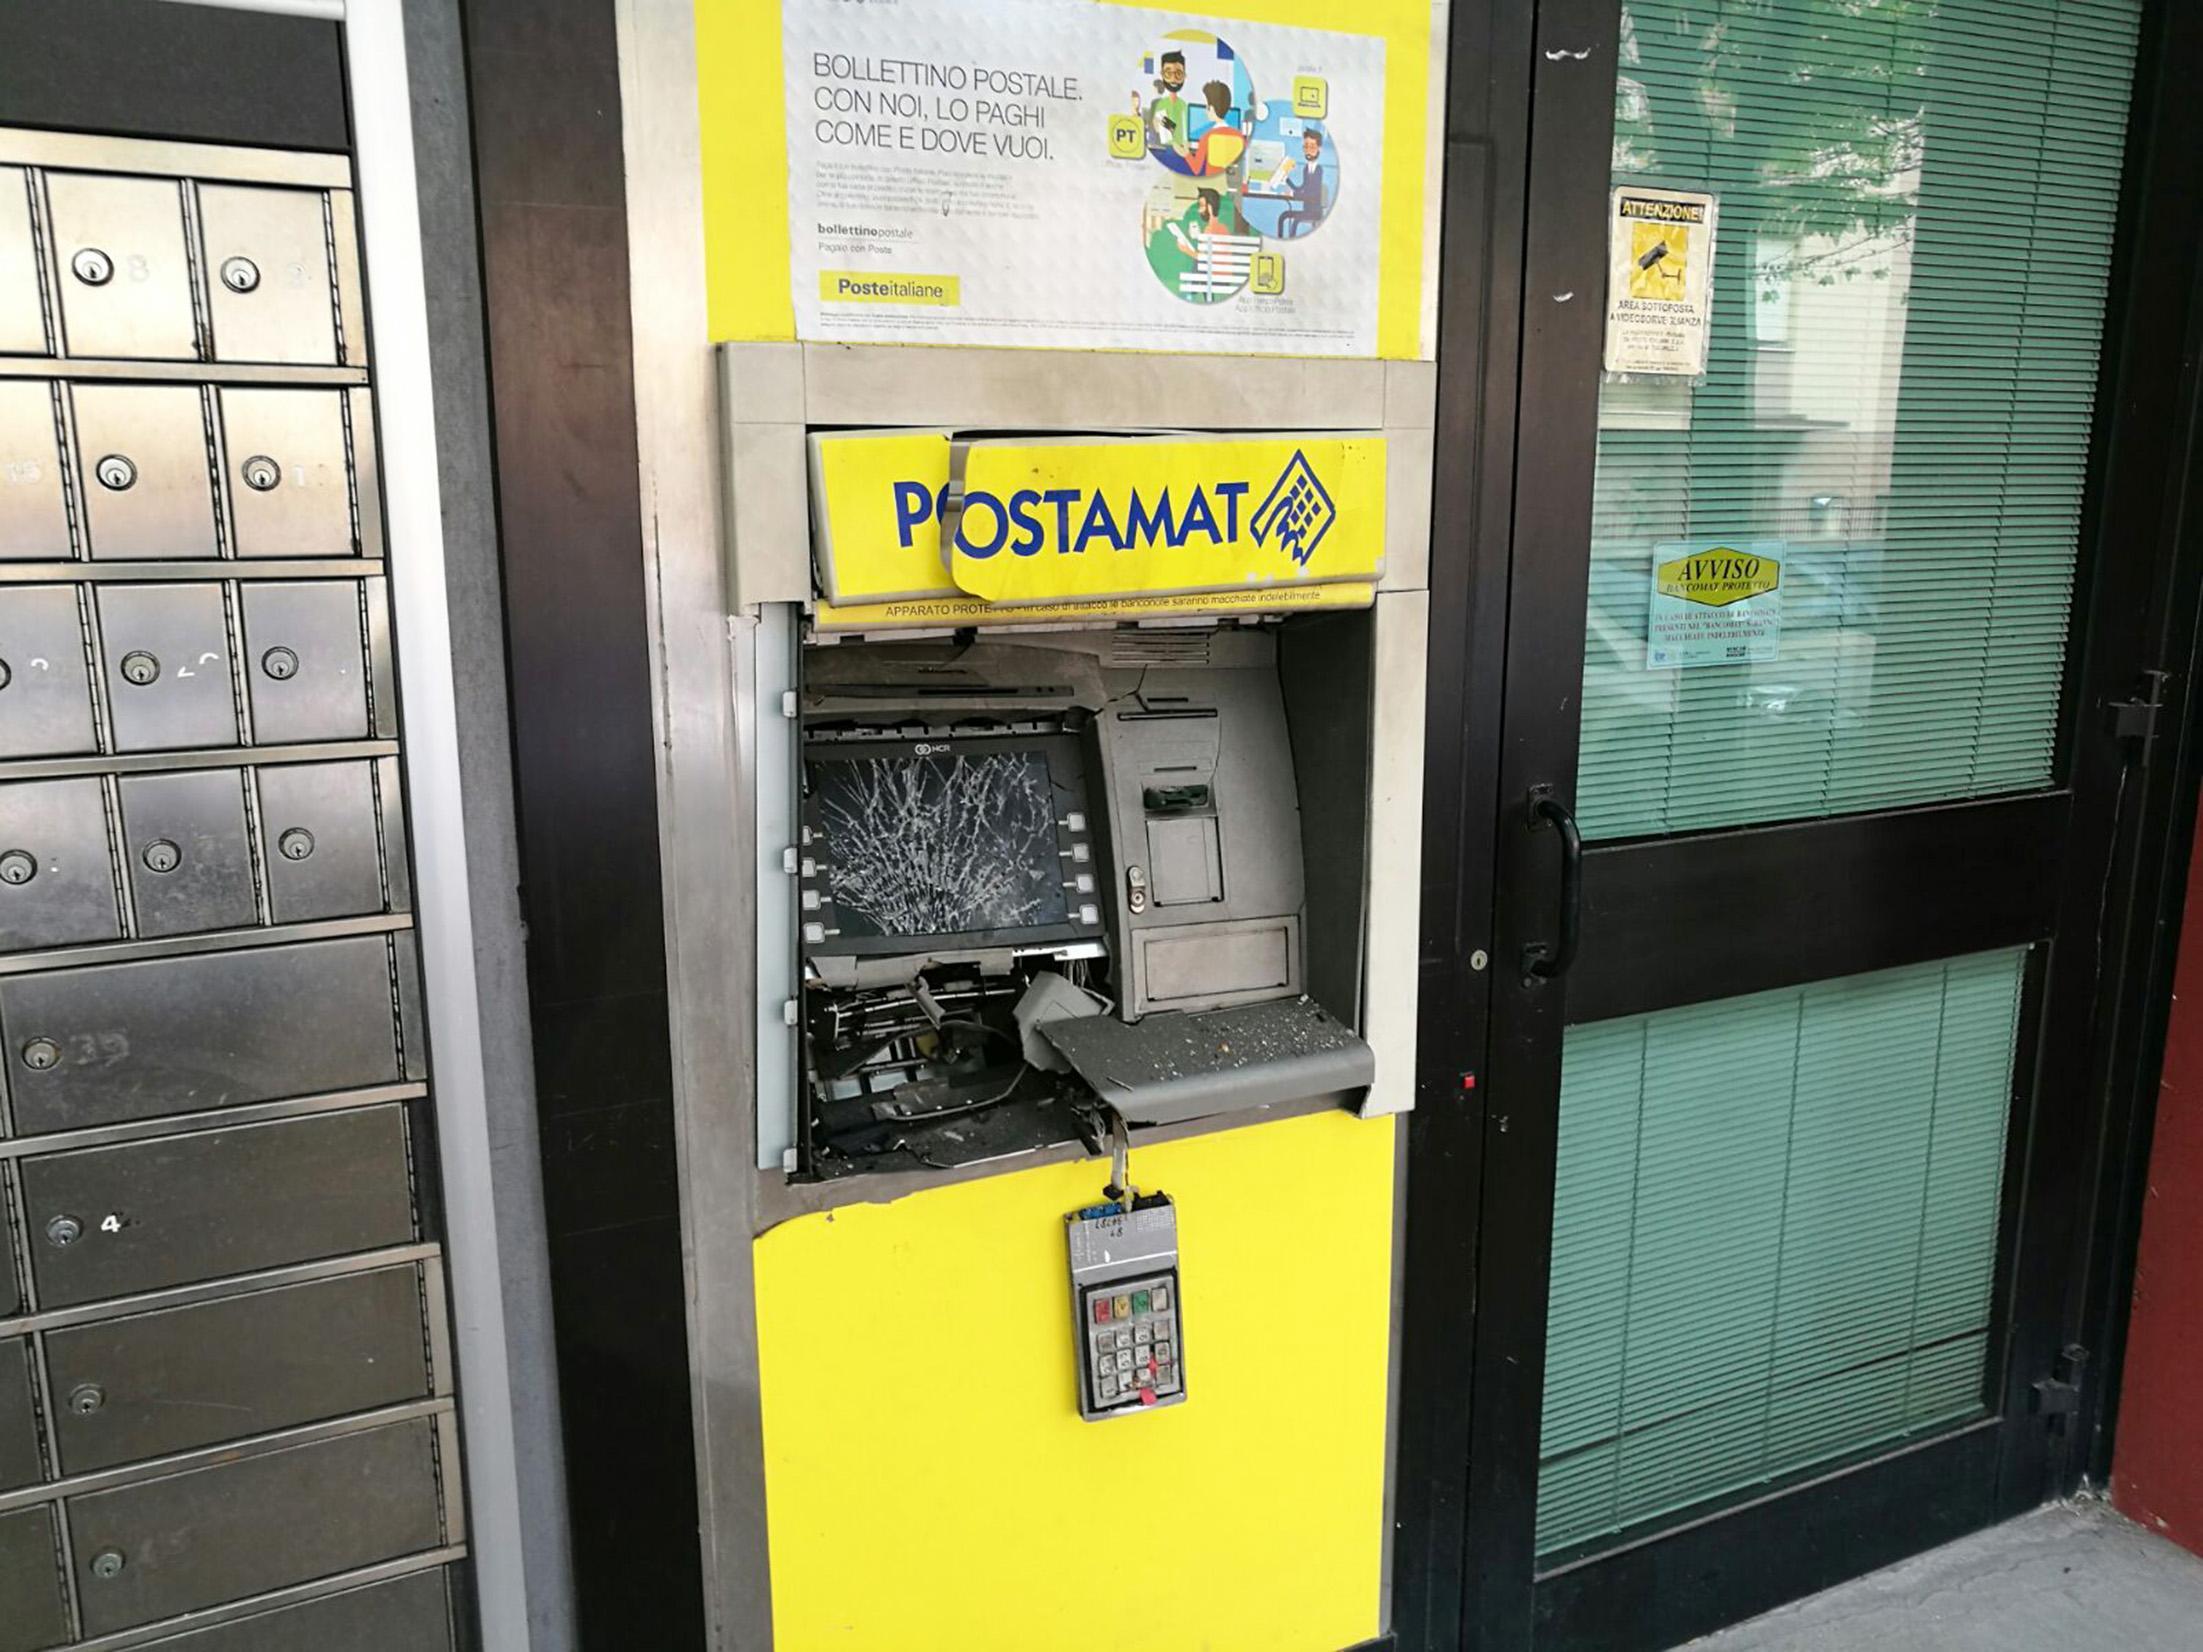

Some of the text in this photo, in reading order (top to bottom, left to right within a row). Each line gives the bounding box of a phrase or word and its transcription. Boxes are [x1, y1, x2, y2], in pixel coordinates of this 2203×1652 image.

[814, 52, 1083, 101] BOLLETTINO POSTALE.
[814, 86, 1045, 128] CON NOI, LO PAGHI
[815, 119, 1054, 160] COME E DOVE VUOI.
[1116, 127, 1136, 143] PT
[1621, 200, 1704, 222] ATTENZIONE!
[818, 223, 913, 239] bollettinopostale
[850, 245, 866, 253] con
[838, 278, 943, 298] Posteitaliane
[1618, 300, 1695, 314] AREA SOTTOPOSTA
[893, 480, 1250, 560] POSTAMAT
[1677, 557, 1761, 582] AVVISO
[886, 605, 950, 617] APPARATO
[953, 602, 1014, 615] PROTEO
[1172, 596, 1210, 607] saranno
[1212, 593, 1256, 605] macchiate
[1259, 590, 1321, 602] indelebilmente
[931, 744, 951, 753] NCR
[100, 1214, 121, 1233] 4
